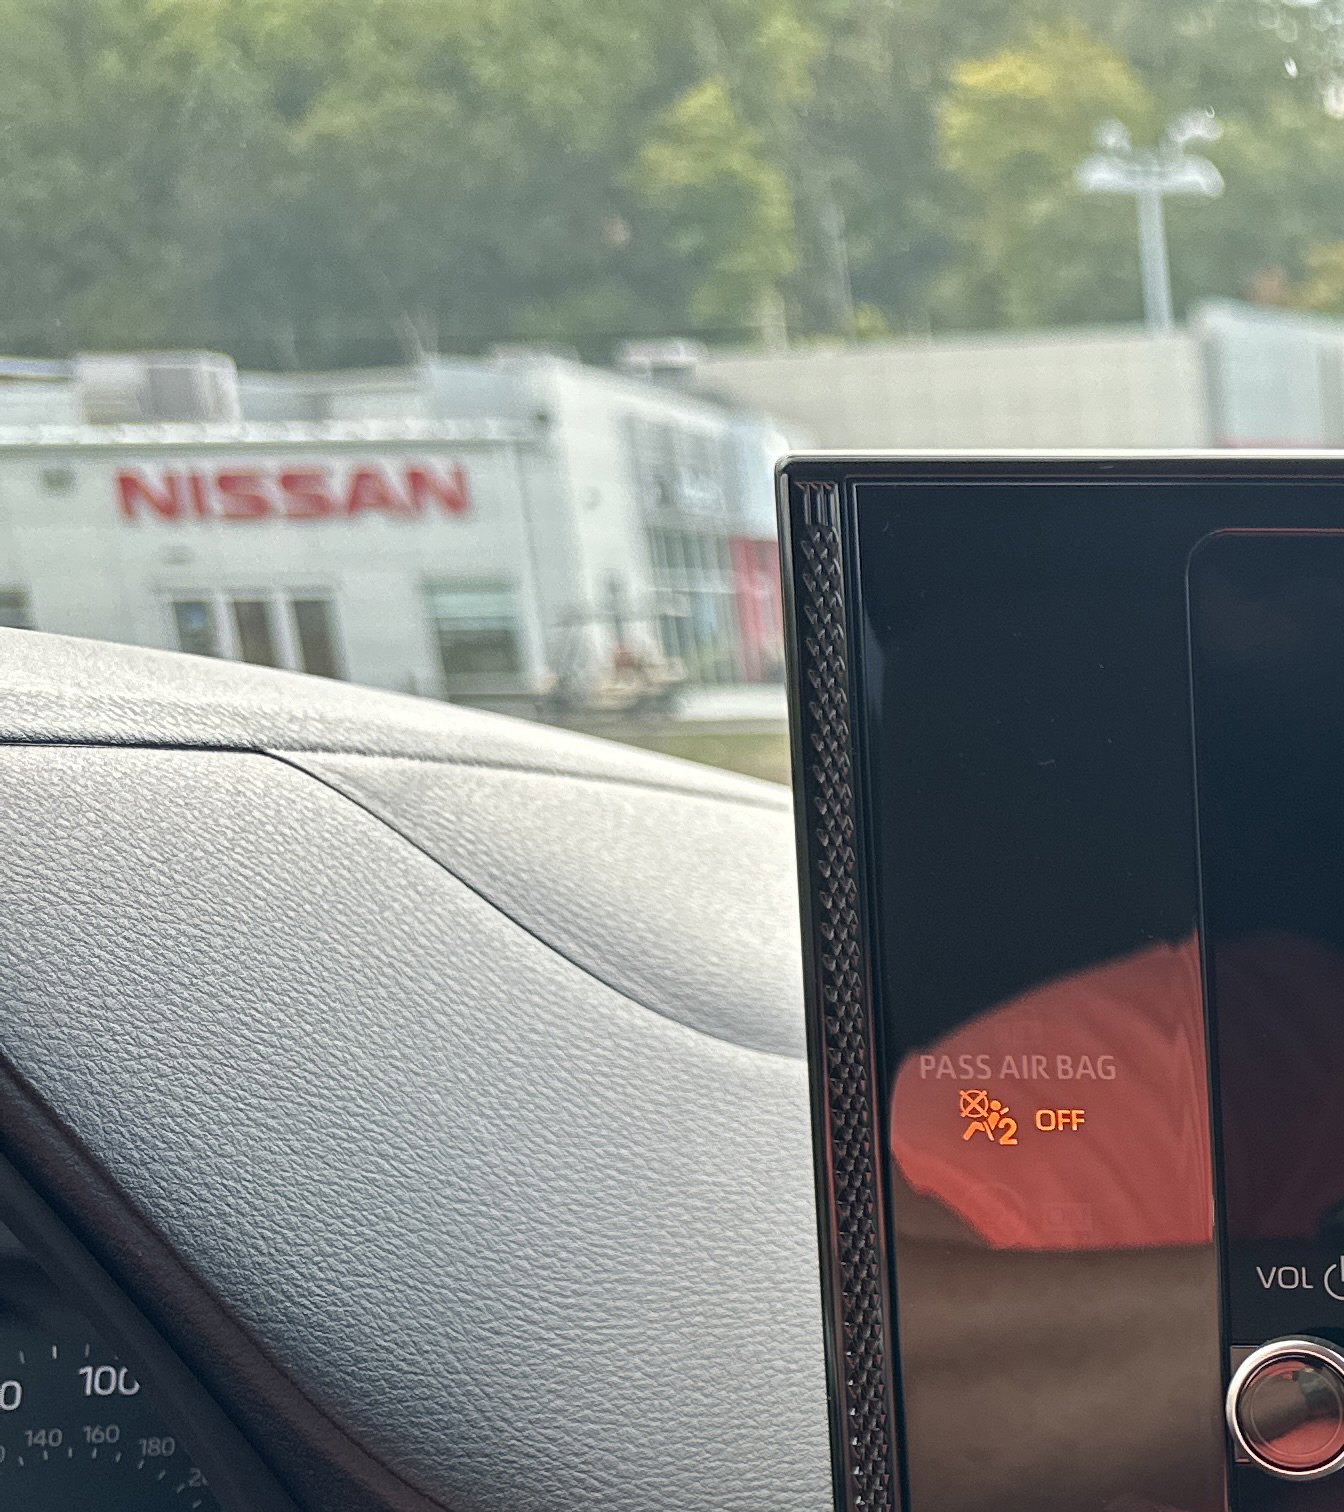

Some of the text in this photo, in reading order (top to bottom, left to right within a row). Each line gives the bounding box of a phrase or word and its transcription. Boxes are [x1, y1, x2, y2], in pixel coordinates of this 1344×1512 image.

[115, 465, 472, 521] NISSAN
[919, 1055, 1117, 1080] PASS AIR BAG
[1035, 1109, 1085, 1131] OFF
[1256, 1266, 1313, 1289] VOL
[24, 1424, 176, 1457] 140 160 180
